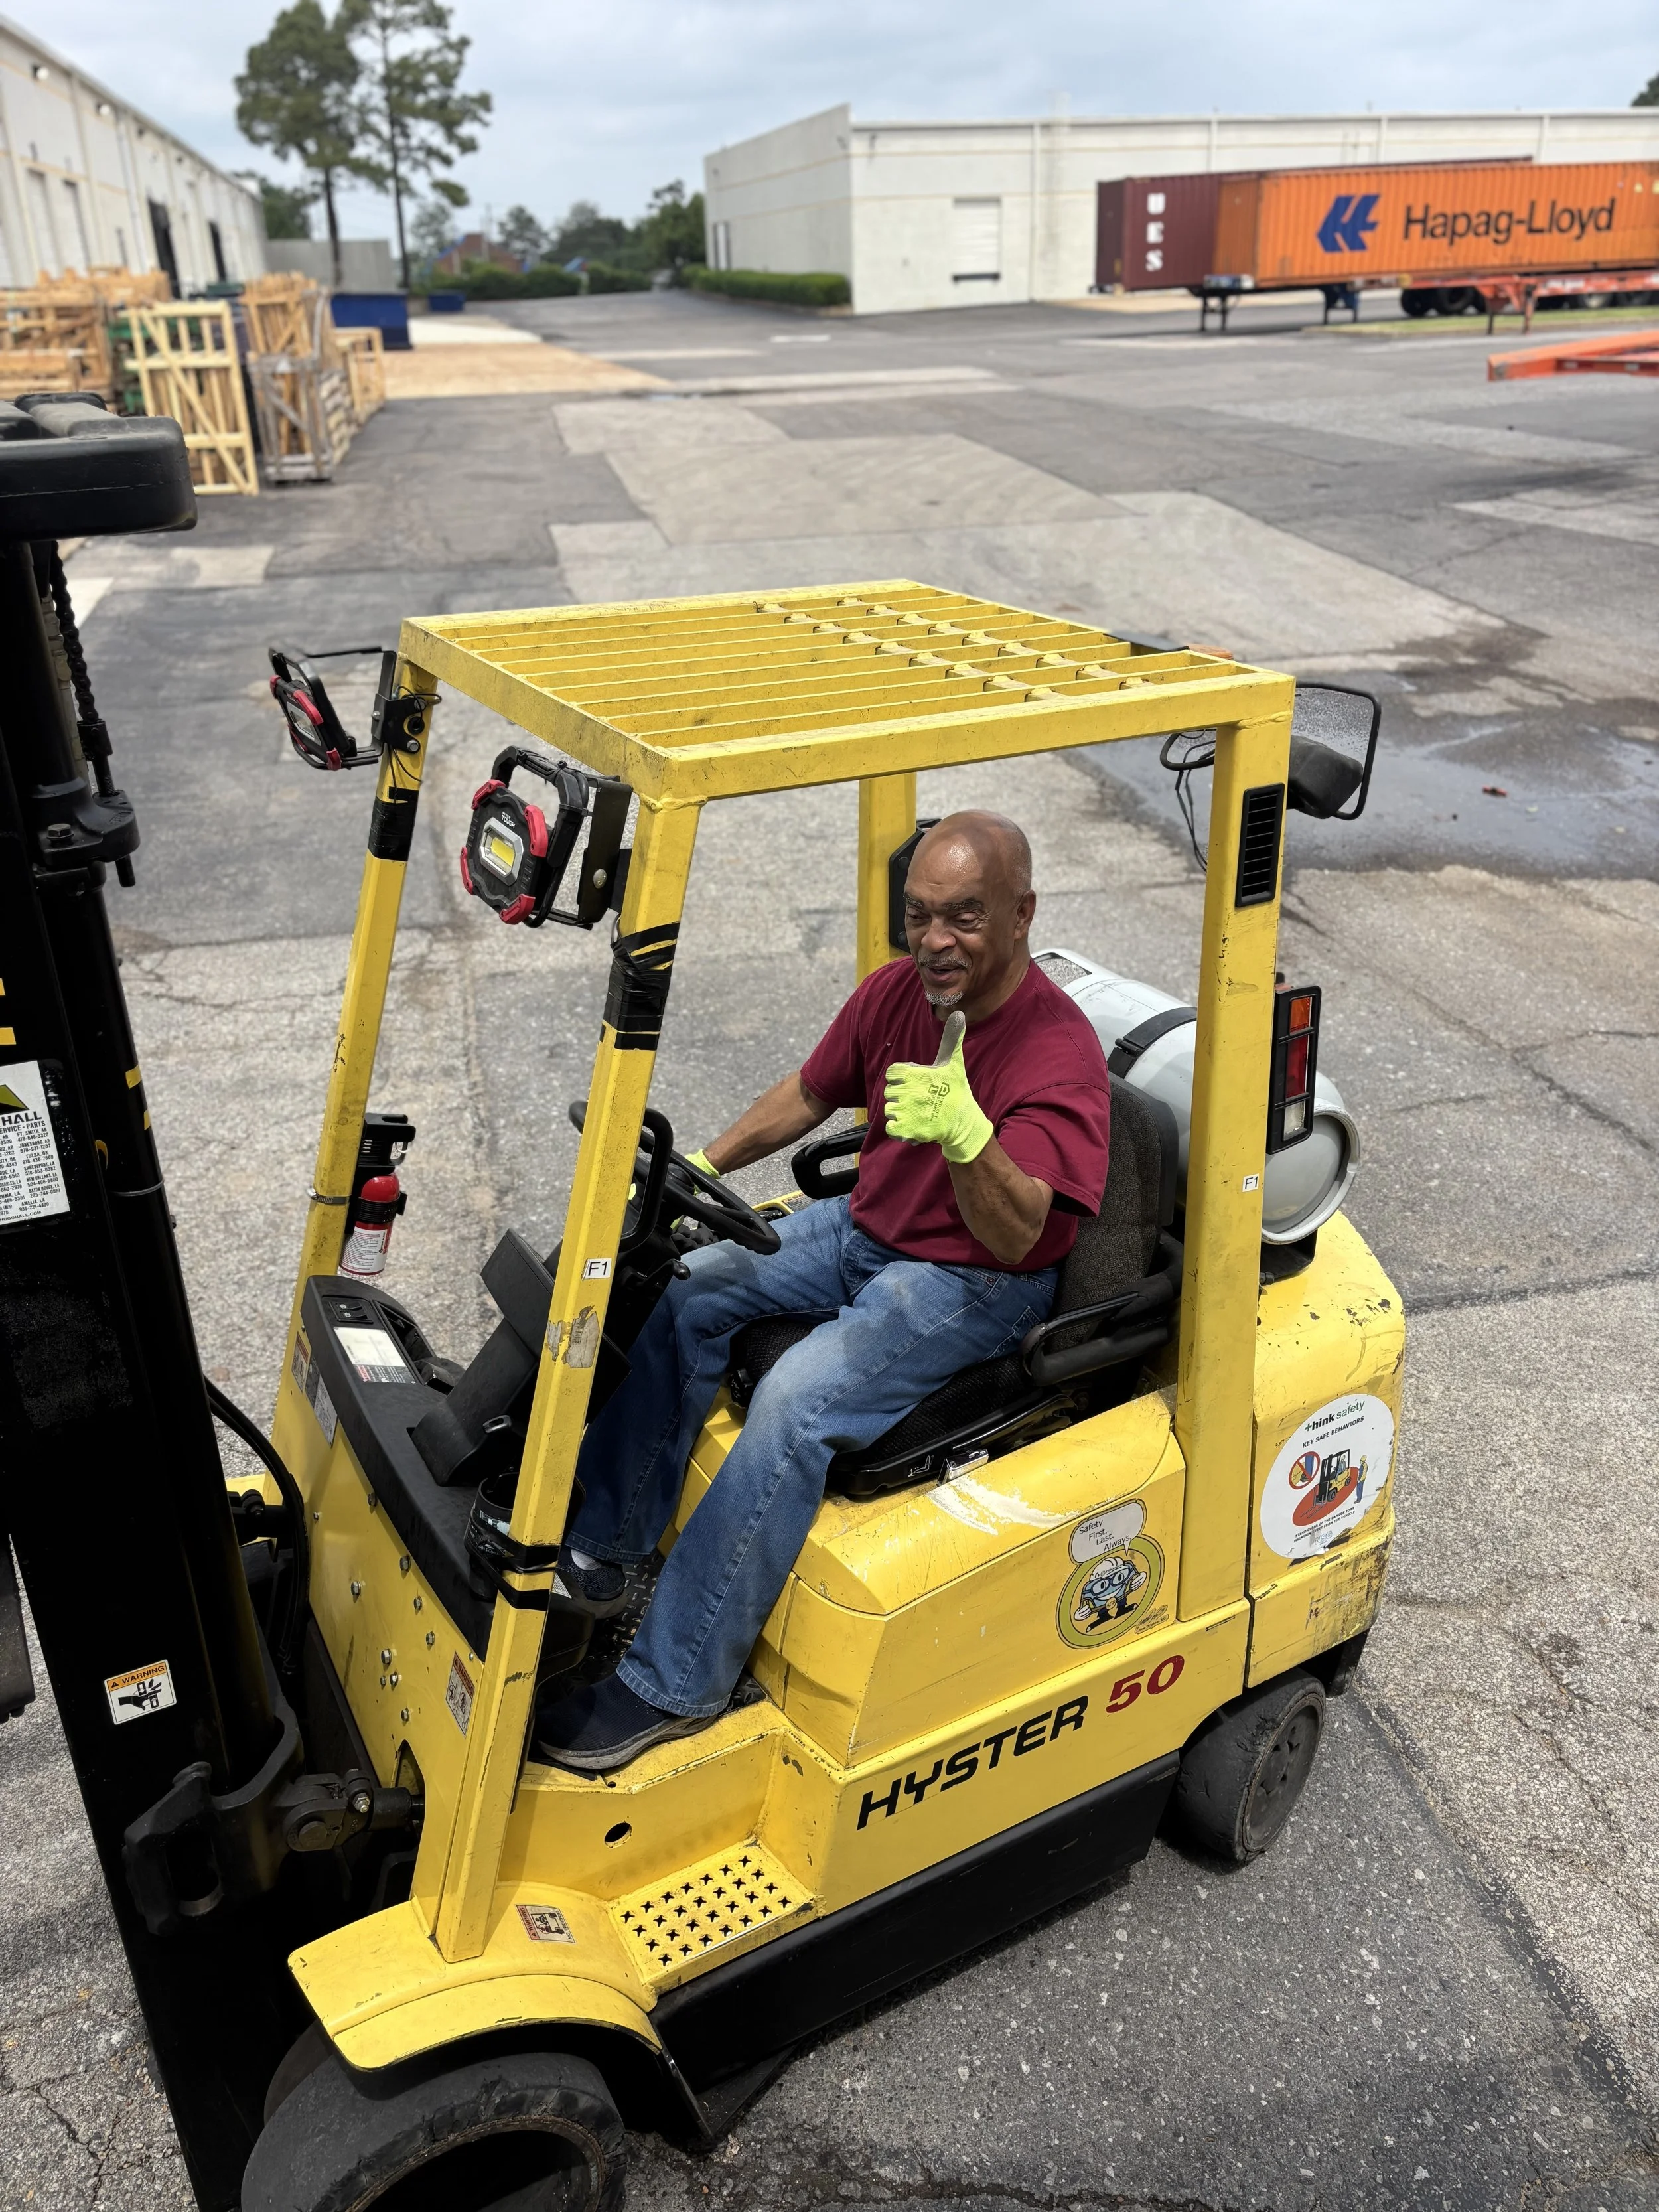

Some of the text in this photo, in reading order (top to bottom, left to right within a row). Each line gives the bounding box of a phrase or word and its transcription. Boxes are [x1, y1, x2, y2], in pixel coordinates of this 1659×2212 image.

[1403, 196, 1617, 246] Hapag-Lloyd
[1, 1111, 42, 1126] HALL
[26, 1120, 46, 1129] PARTS
[1244, 1175, 1258, 1191] F1
[588, 1260, 609, 1277] F1
[1336, 1400, 1365, 1420] safety
[1302, 1416, 1364, 1448] KEY SAFE BEHAVIORS
[1331, 1511, 1345, 1520] DANGER
[1079, 1519, 1103, 1535] Safety
[1096, 1533, 1114, 1546] Last.
[1104, 1534, 1132, 1552] Always.
[1315, 1530, 1333, 1545] NSG
[121, 1665, 165, 1684] WARNING
[856, 1655, 1185, 1831] HYSTER 50
[520, 1907, 534, 1931] WARNING
